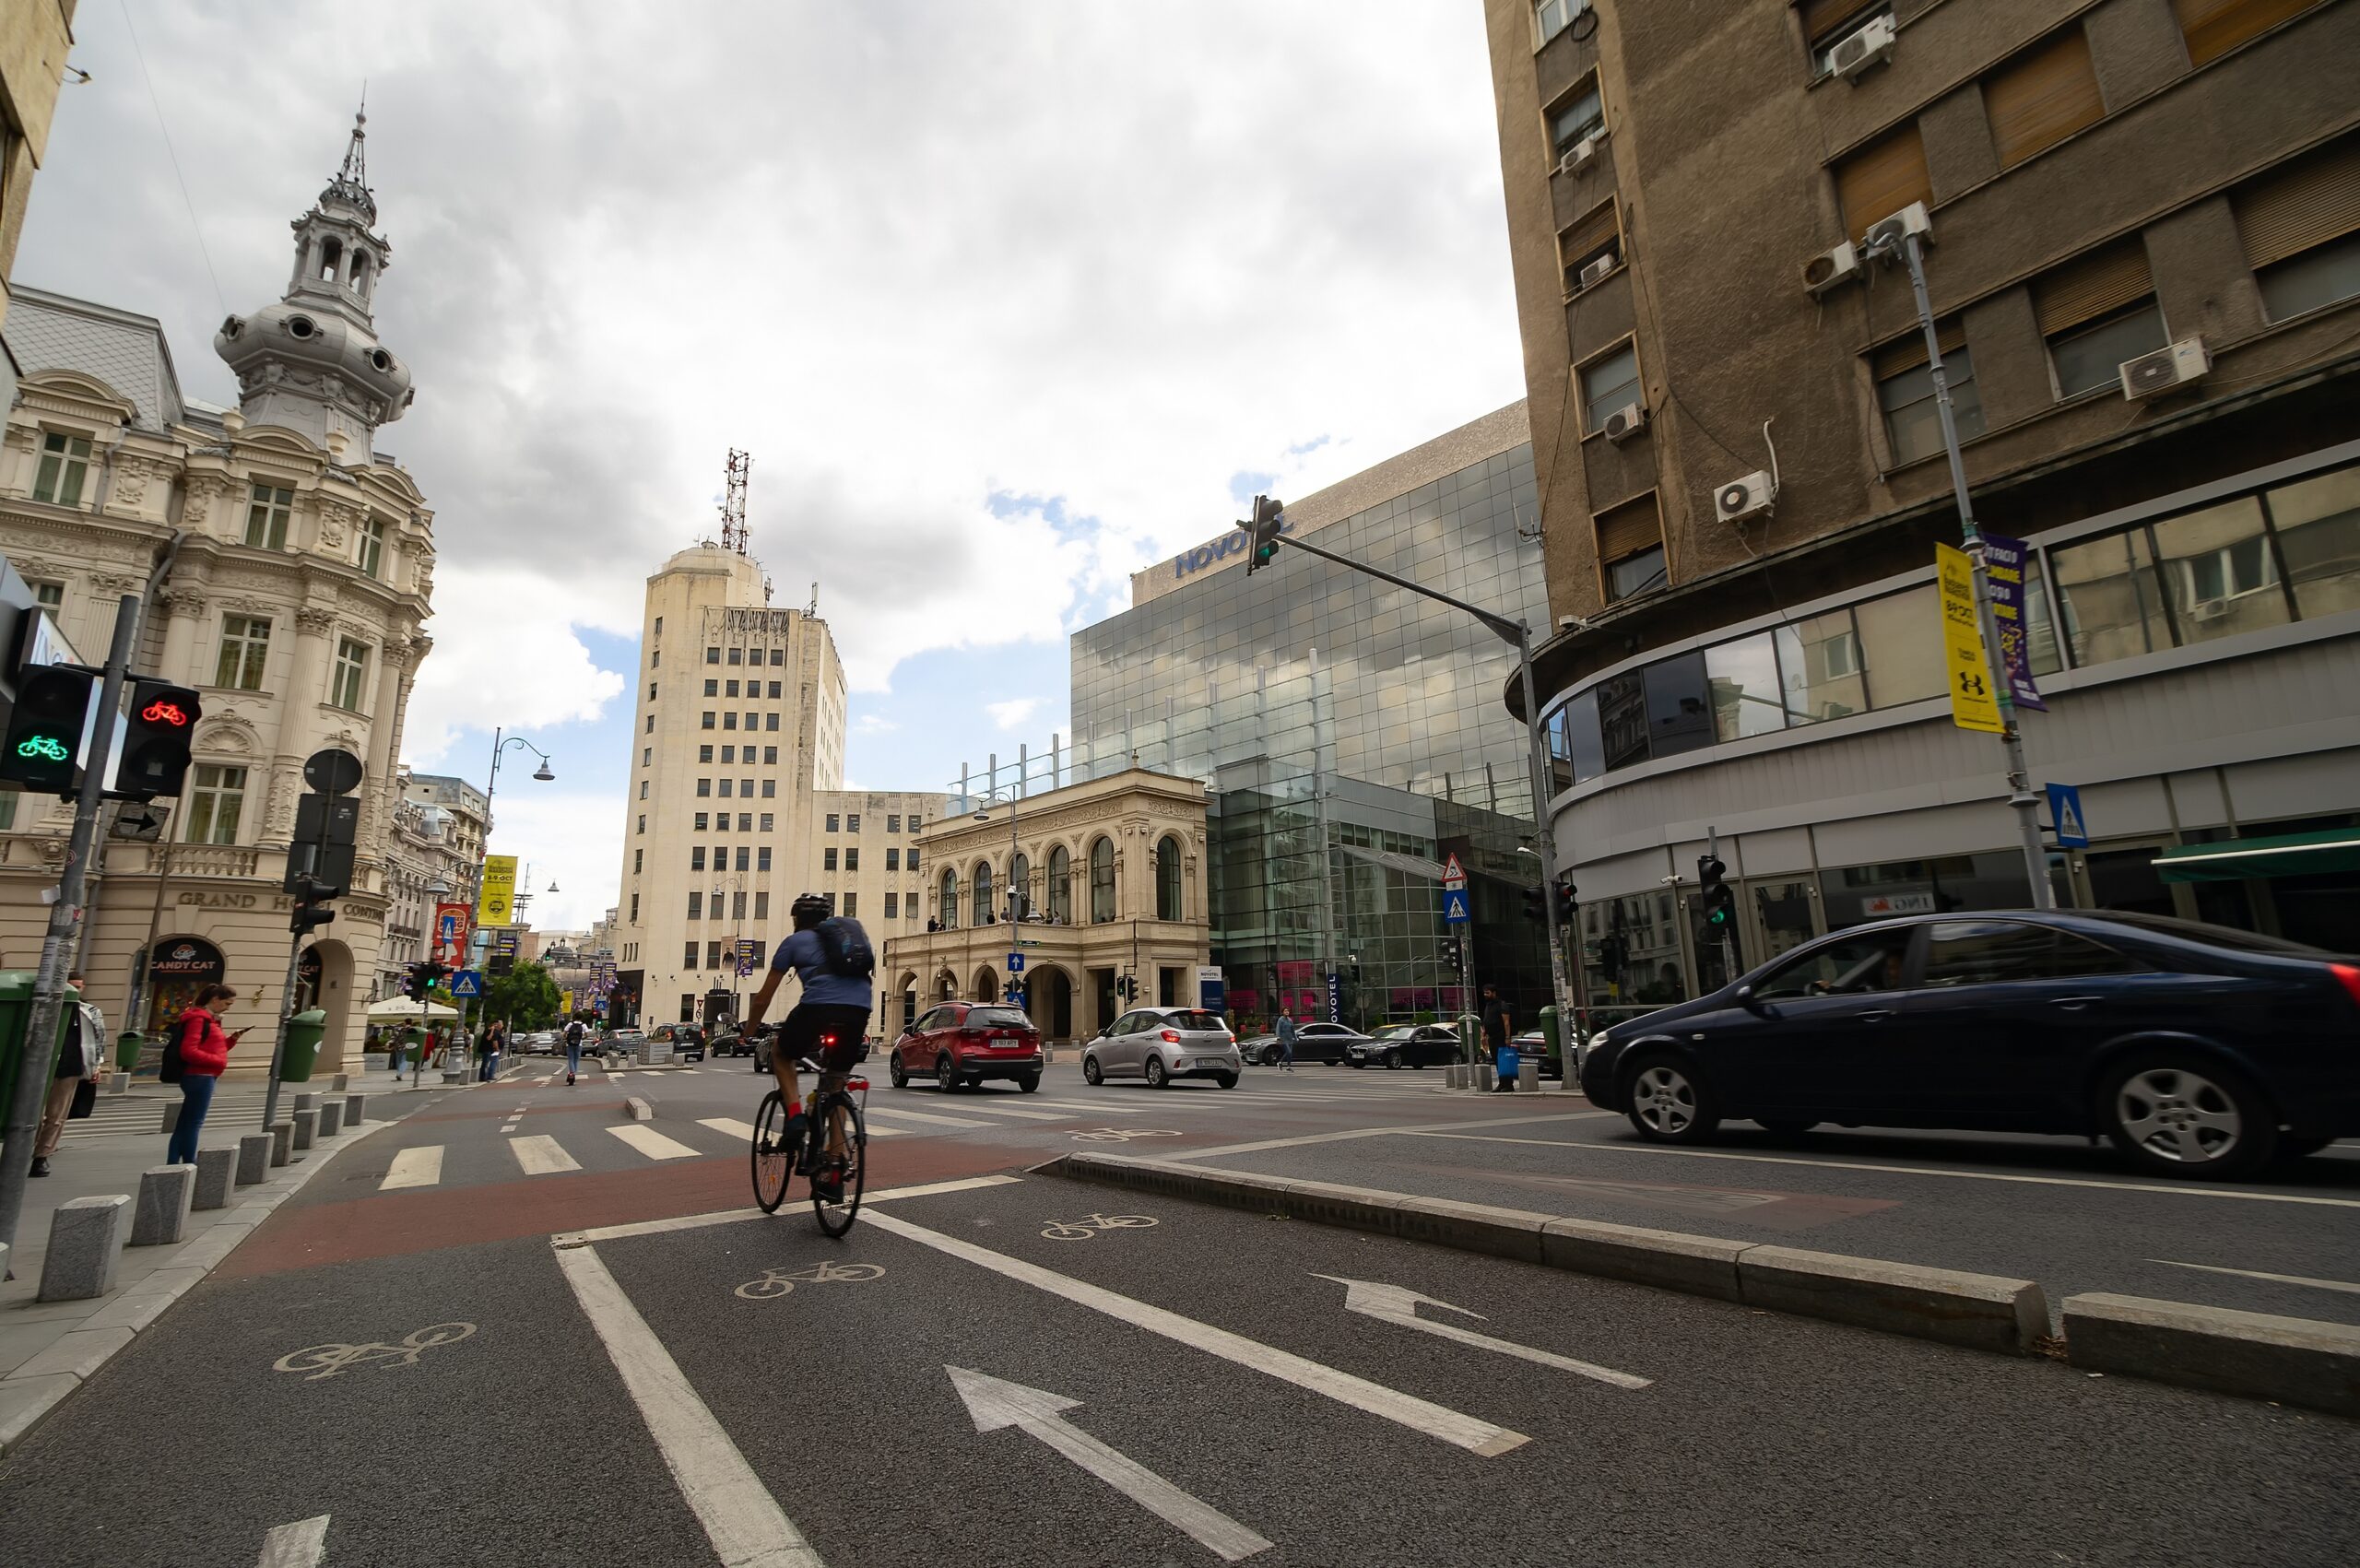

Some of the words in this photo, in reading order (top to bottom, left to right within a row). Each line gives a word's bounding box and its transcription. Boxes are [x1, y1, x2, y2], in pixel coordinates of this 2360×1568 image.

[1175, 513, 1294, 579] NOVOL
[177, 892, 257, 909] GRAND
[192, 961, 216, 970] CAT
[1329, 975, 1338, 1023] OVOTEL
